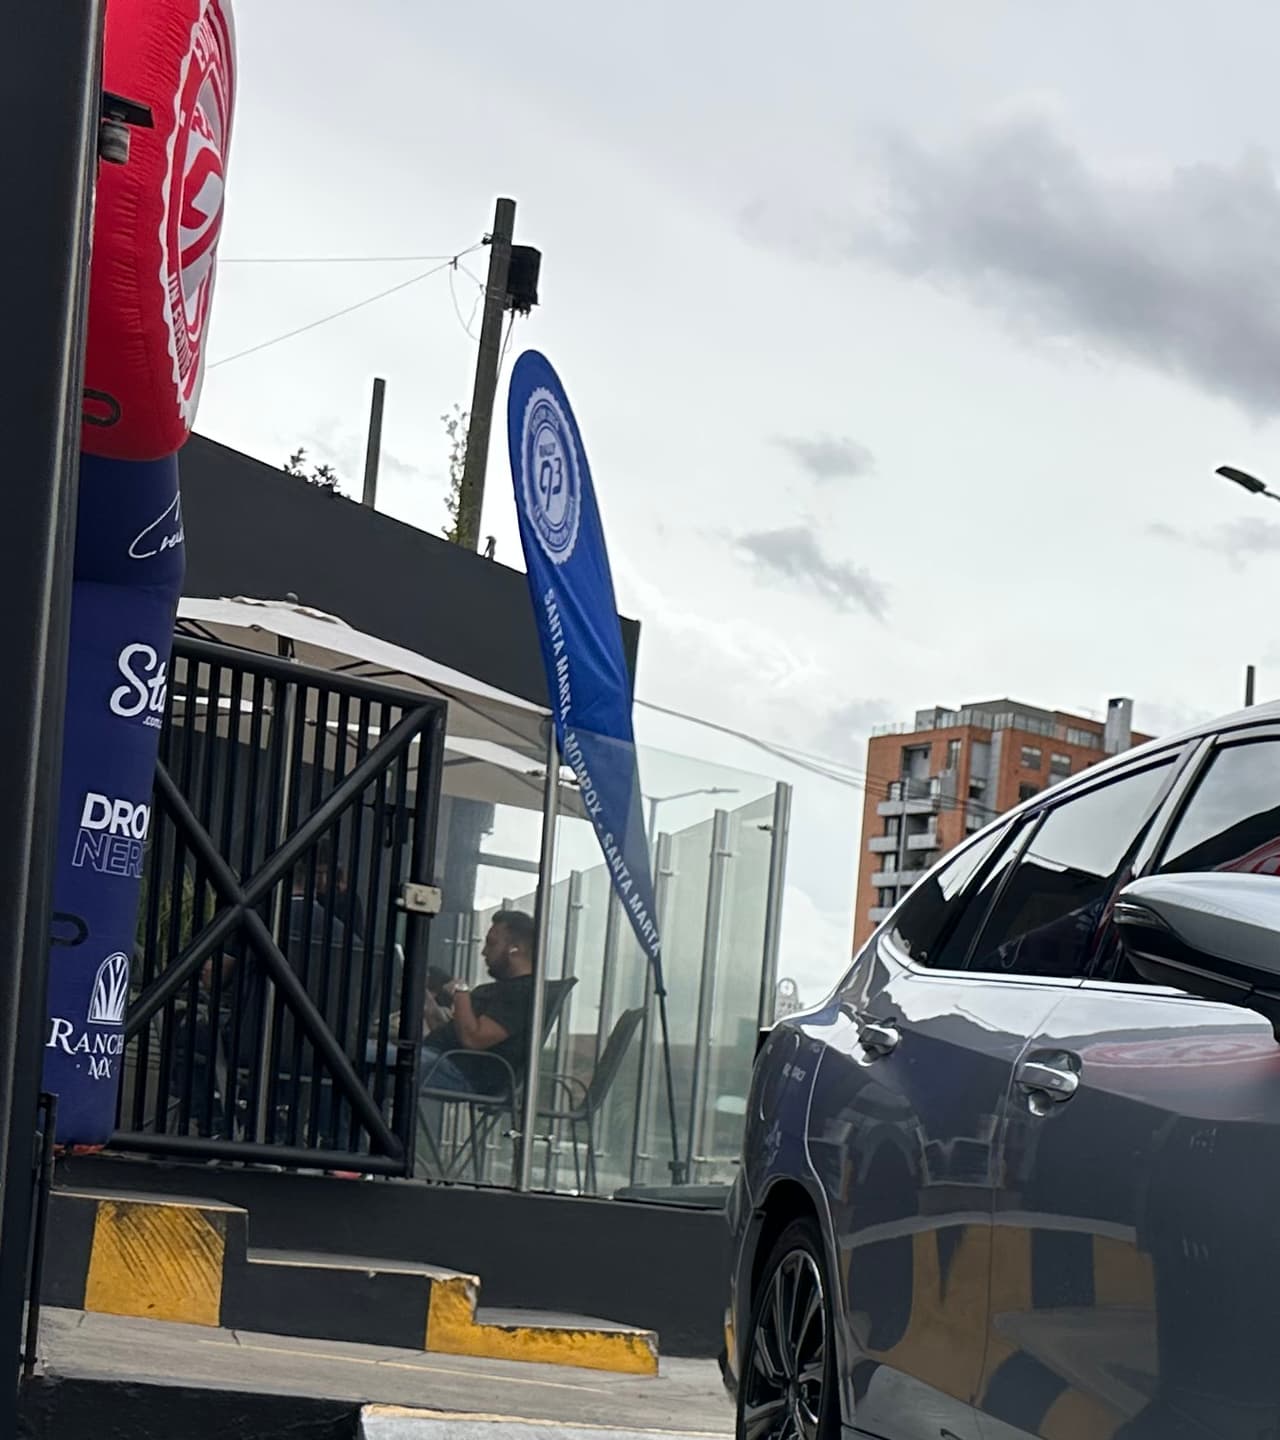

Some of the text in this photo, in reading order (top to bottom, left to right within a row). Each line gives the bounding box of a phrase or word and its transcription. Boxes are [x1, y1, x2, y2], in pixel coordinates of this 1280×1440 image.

[540, 457, 563, 512] 93
[544, 588, 565, 656] SANTA
[556, 655, 571, 722] MARTA
[564, 732, 603, 819] MOMPOX
[603, 832, 633, 895] SANTA
[628, 893, 663, 957] MARTA
